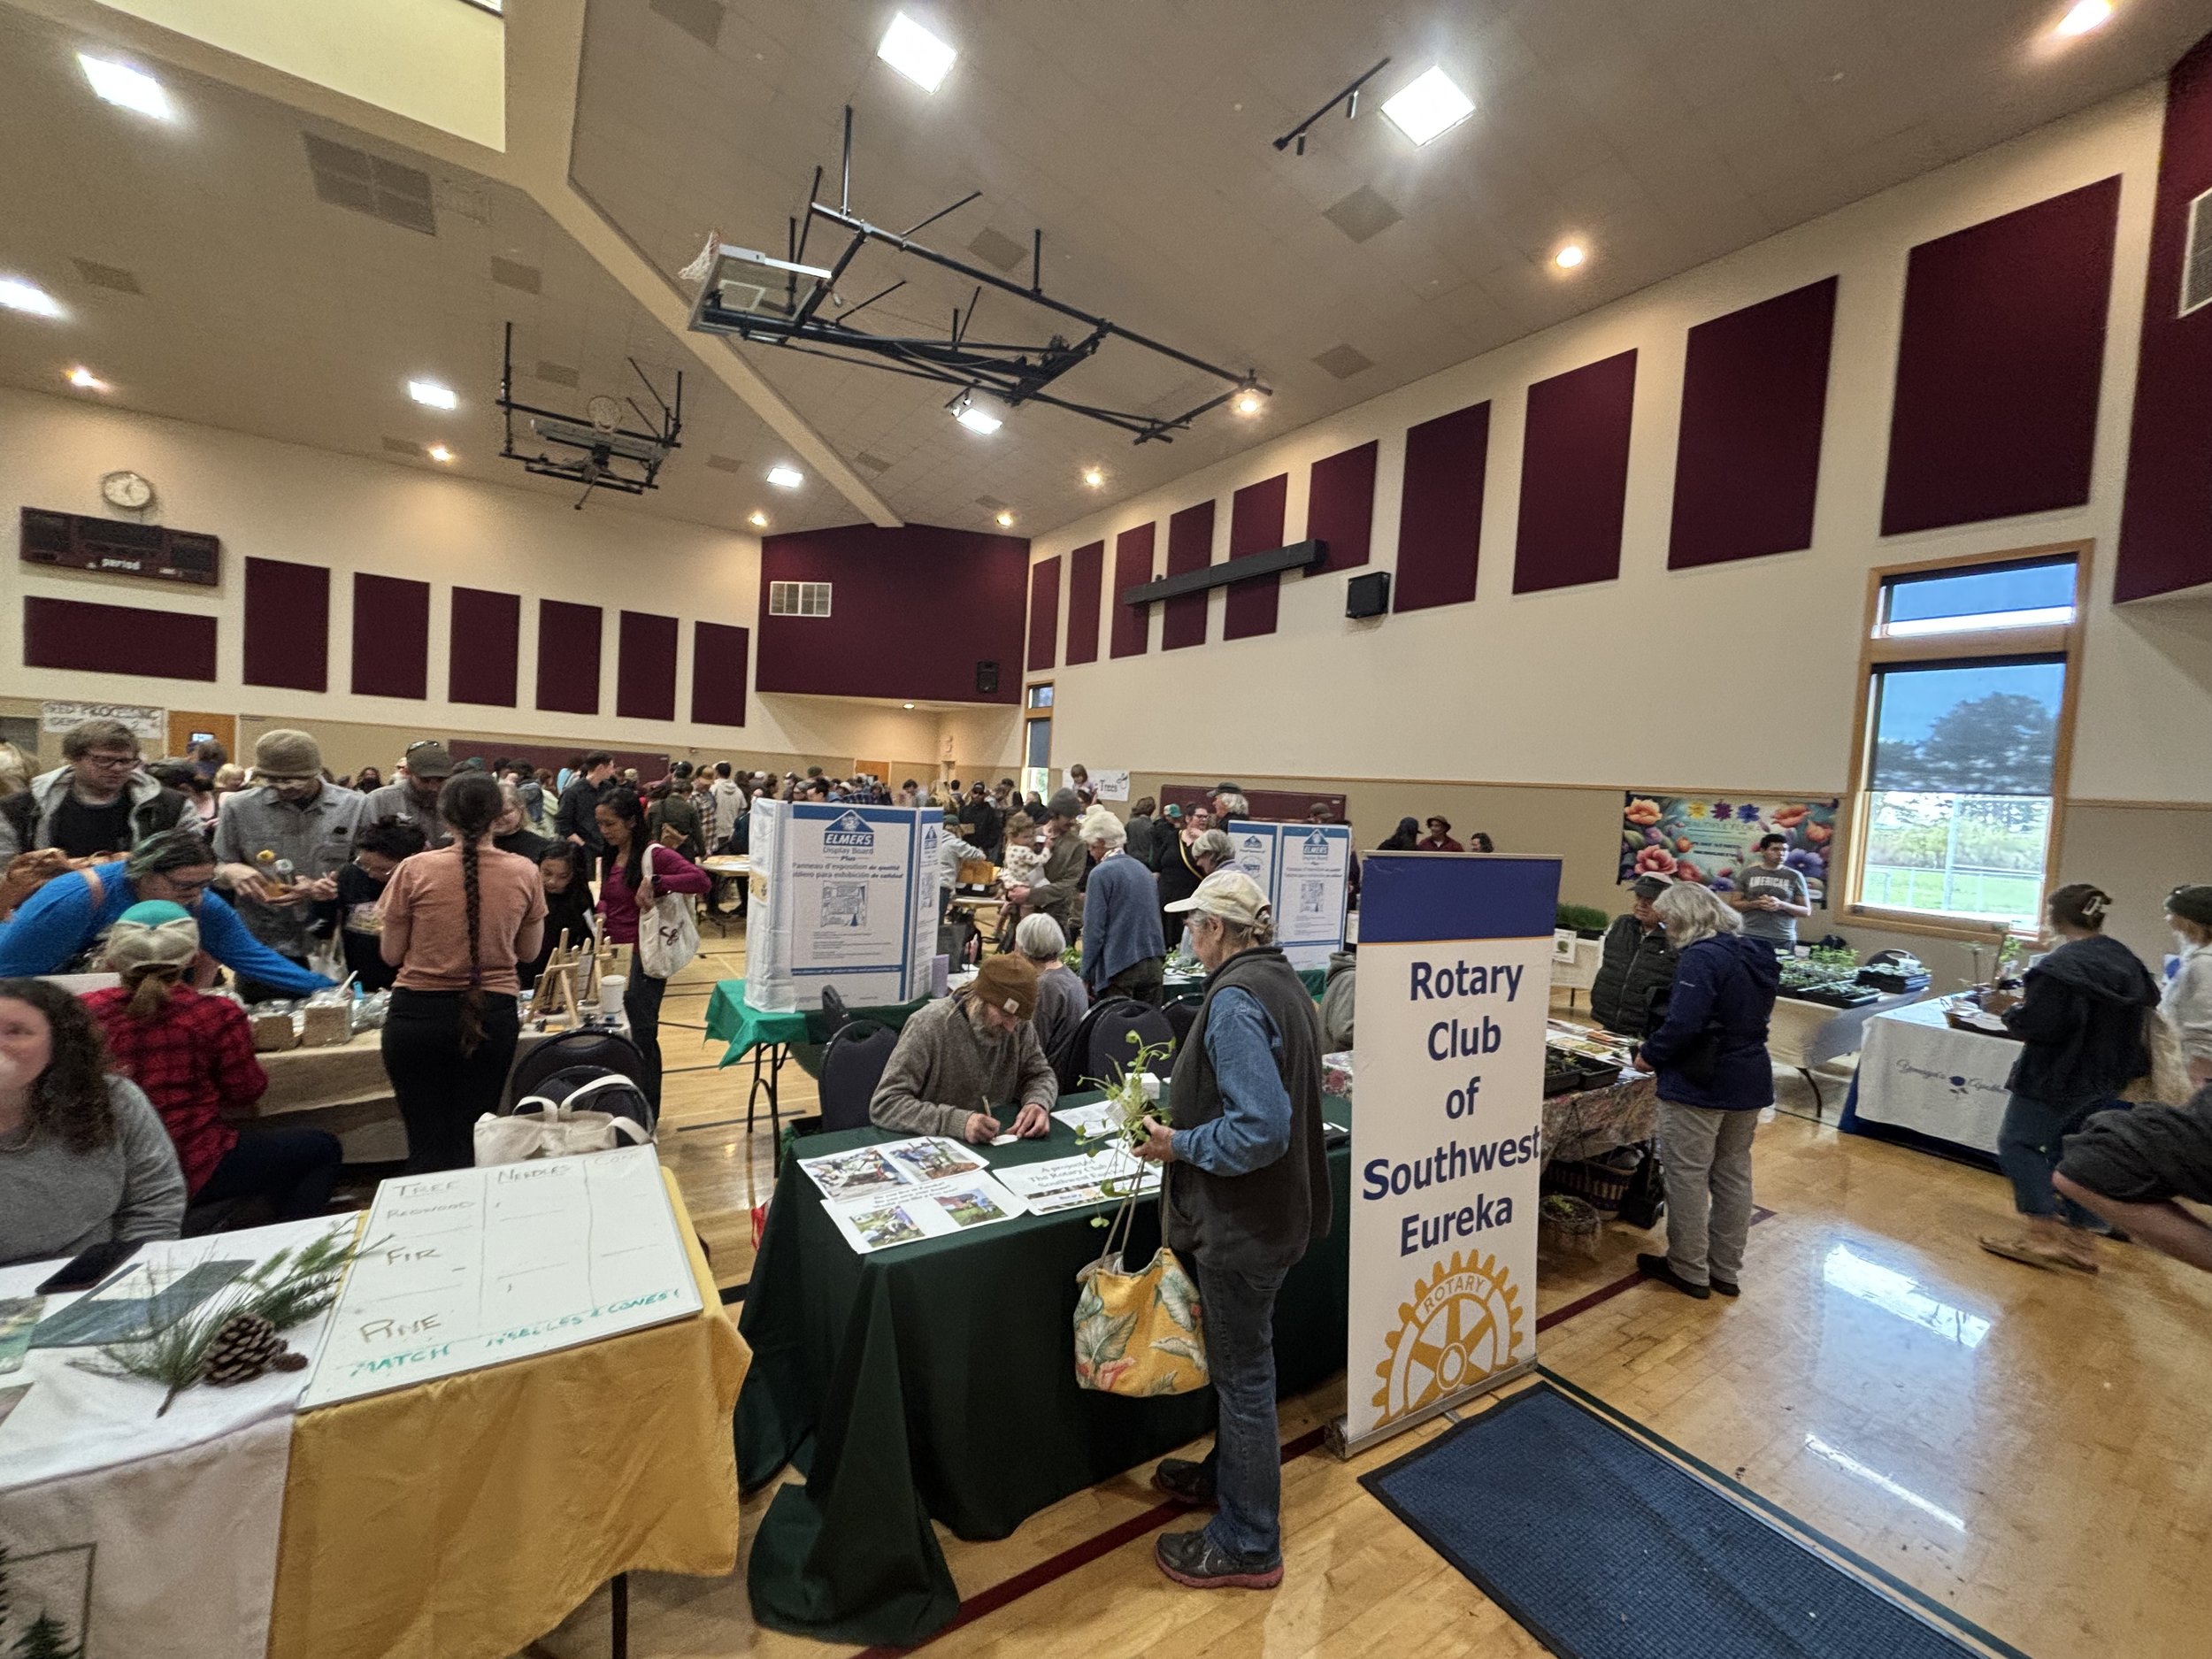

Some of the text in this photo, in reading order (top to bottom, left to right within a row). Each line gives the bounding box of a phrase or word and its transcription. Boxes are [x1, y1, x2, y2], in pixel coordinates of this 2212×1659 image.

[823, 846, 850, 855] Display
[826, 833, 872, 845] ELMER'S
[1410, 961, 1524, 1002] Rotary
[1428, 1016, 1501, 1062] Club
[1446, 1076, 1481, 1120] of
[1029, 1175, 1048, 1184] The
[1363, 1125, 1540, 1201] Southwest
[1401, 1195, 1513, 1257] Eureka
[387, 1246, 442, 1265] FIR
[1423, 1275, 1486, 1313] ROTARY
[360, 1314, 442, 1343] PINE
[349, 1344, 452, 1377] MATCH
